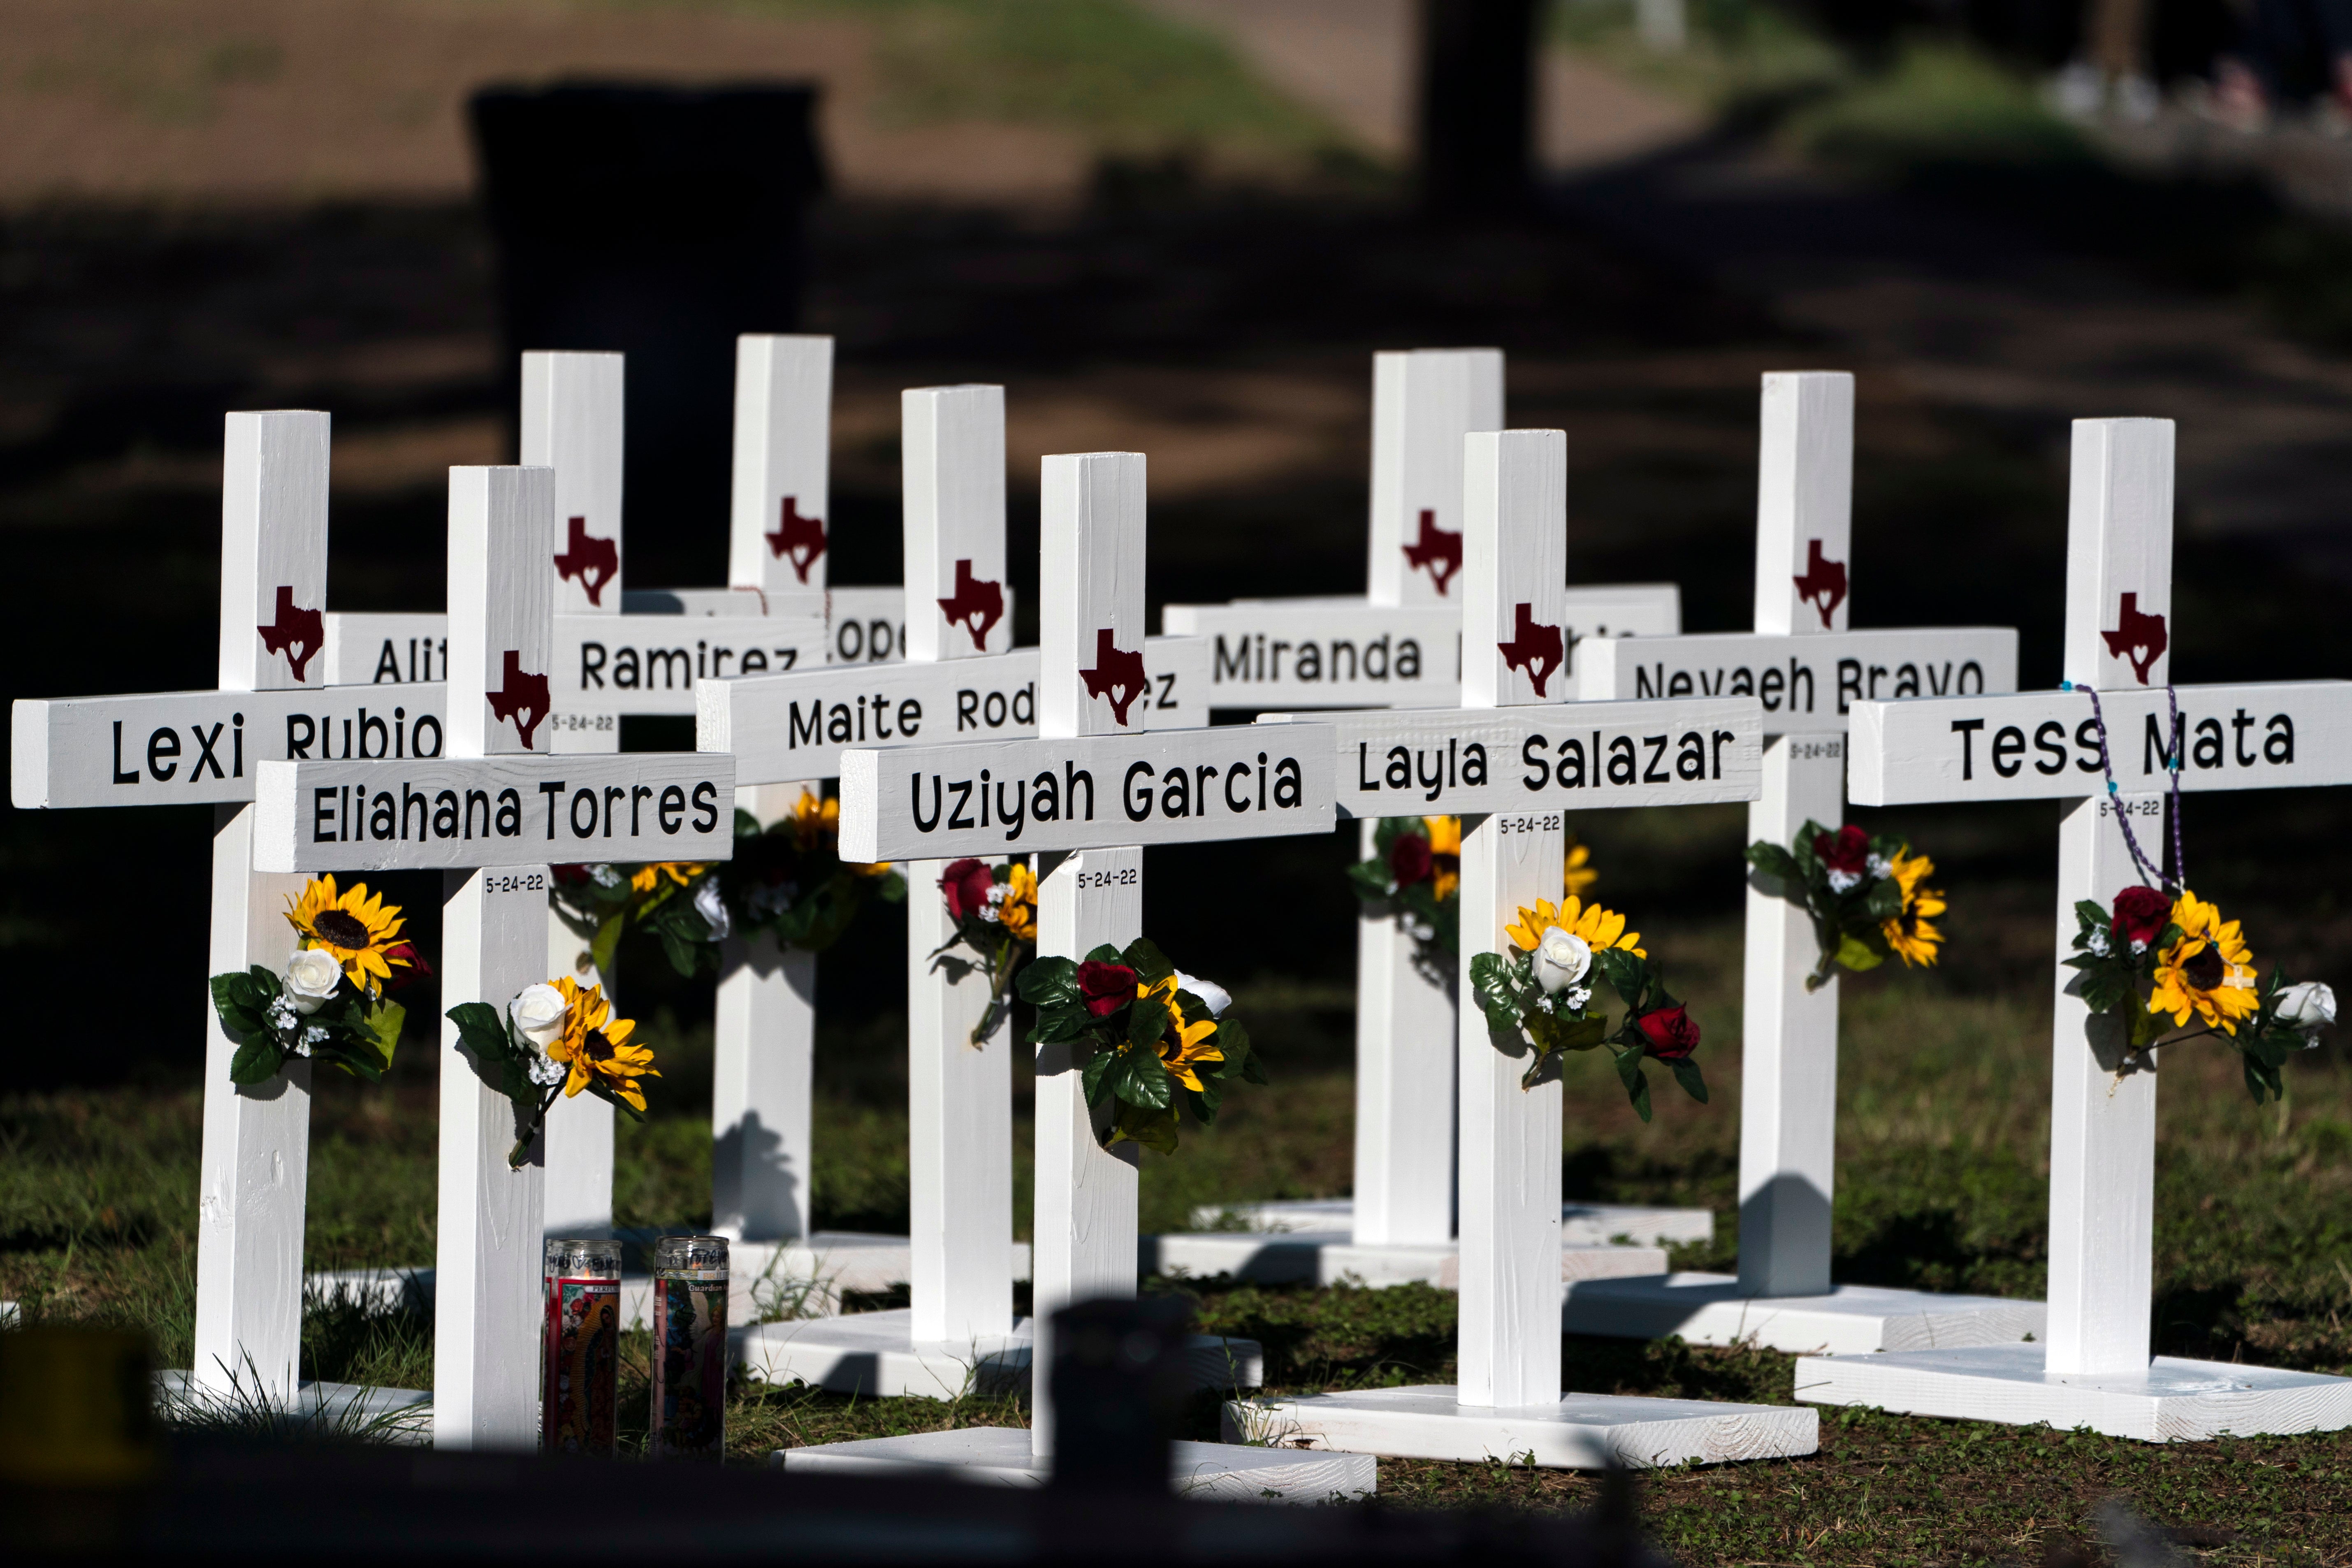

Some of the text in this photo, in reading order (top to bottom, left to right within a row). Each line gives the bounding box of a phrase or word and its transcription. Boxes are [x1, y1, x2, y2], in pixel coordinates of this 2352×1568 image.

[581, 640, 798, 690] Ramirez
[1214, 634, 1421, 683] Miranda
[1635, 656, 1984, 715] Nevaeh Bravo
[112, 707, 443, 785] Lexi Rubio
[552, 714, 613, 731] 5-24-22
[789, 694, 922, 750] Maite
[1951, 709, 2294, 781] Tess Mata
[1359, 729, 1735, 802] Layla Salazar
[313, 780, 718, 844] Eliahana Torres
[911, 751, 1302, 842] Uziyah Garcia
[2100, 801, 2159, 817] 5-4-22
[1501, 815, 1560, 835] 5-24-22
[486, 874, 544, 894] 5-24-22
[1078, 868, 1137, 889] 5-24-22
